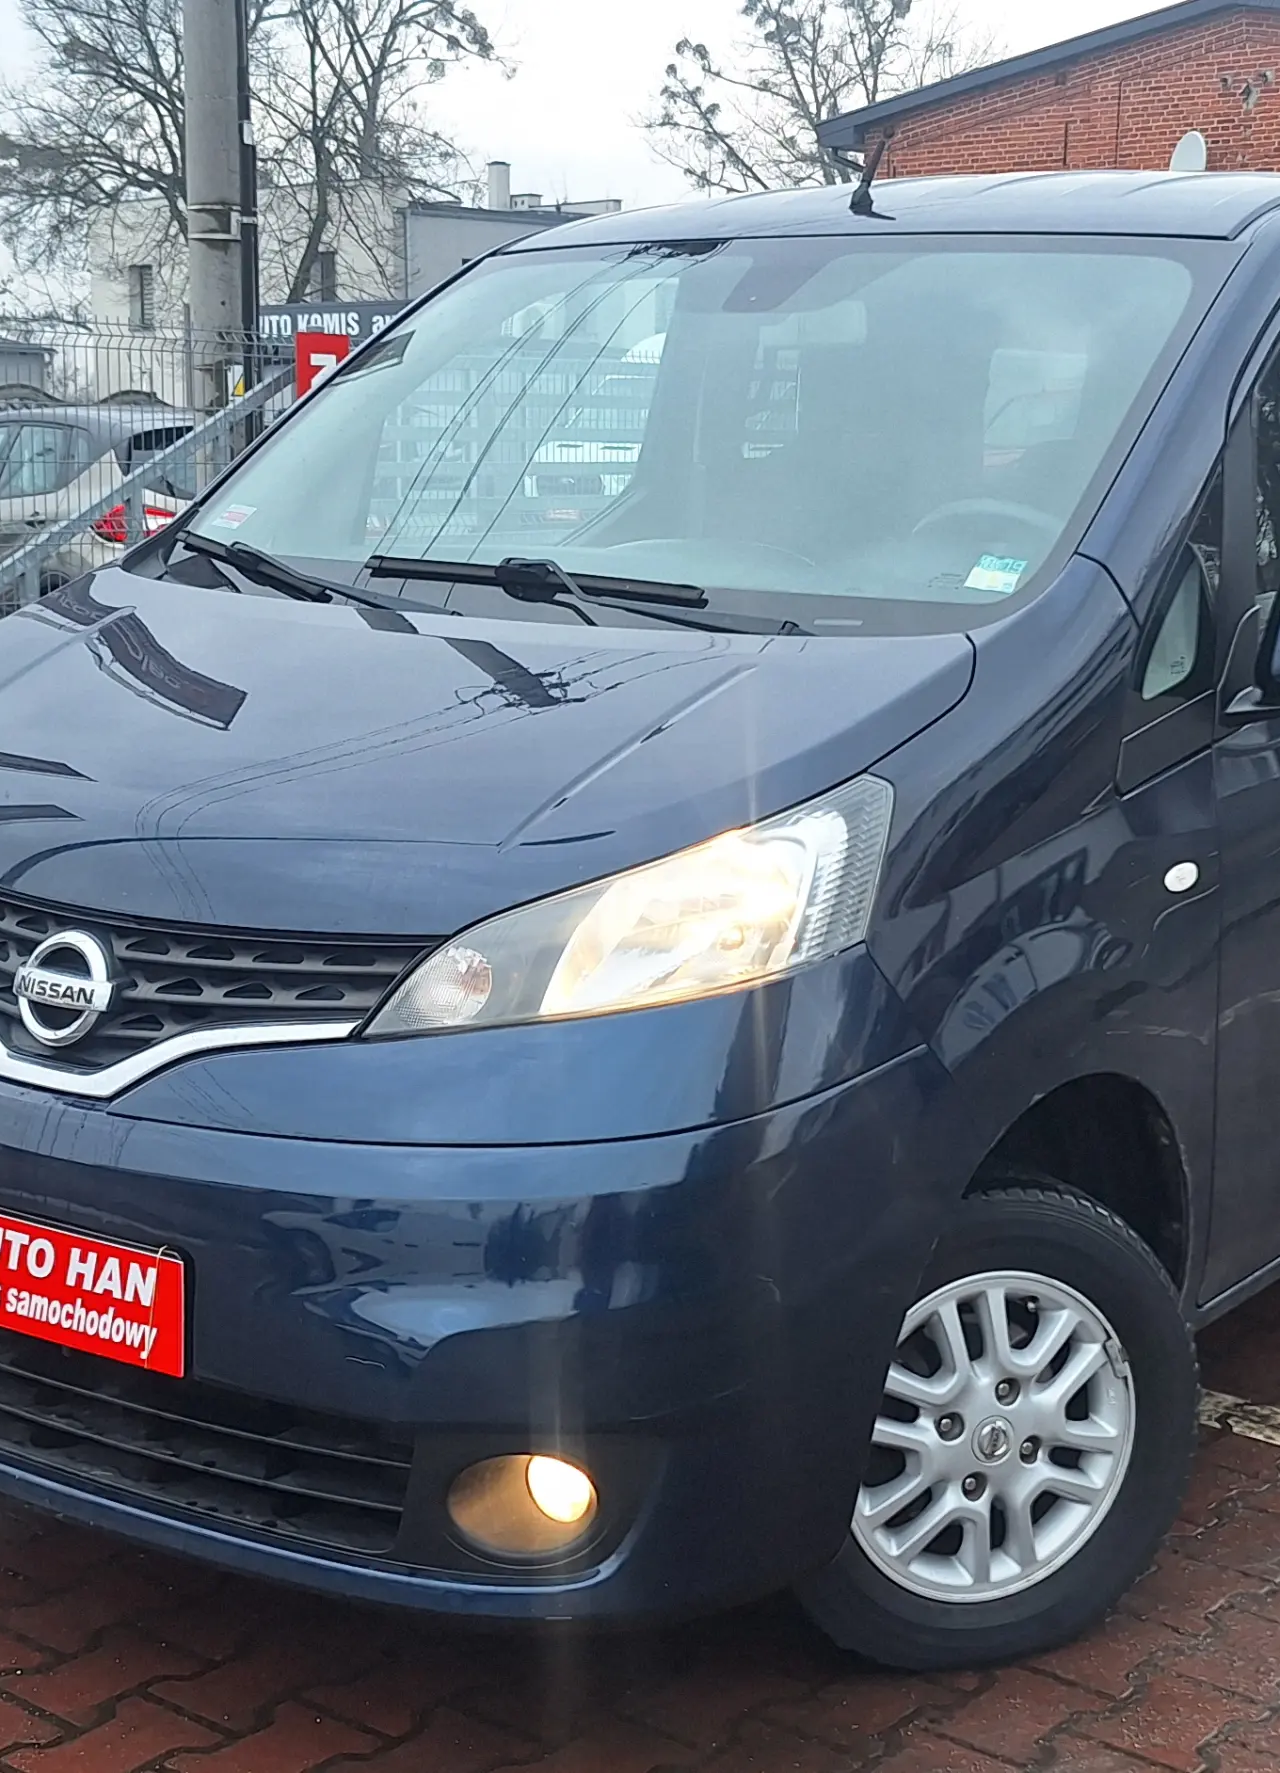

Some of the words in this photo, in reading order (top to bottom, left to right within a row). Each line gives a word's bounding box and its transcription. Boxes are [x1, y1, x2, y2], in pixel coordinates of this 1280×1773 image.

[259, 314, 292, 339] UTO
[296, 311, 360, 336] KOMIS
[19, 974, 95, 1005] NISSAN
[65, 1247, 158, 1307] HAN
[5, 1287, 158, 1360] samochodowy
